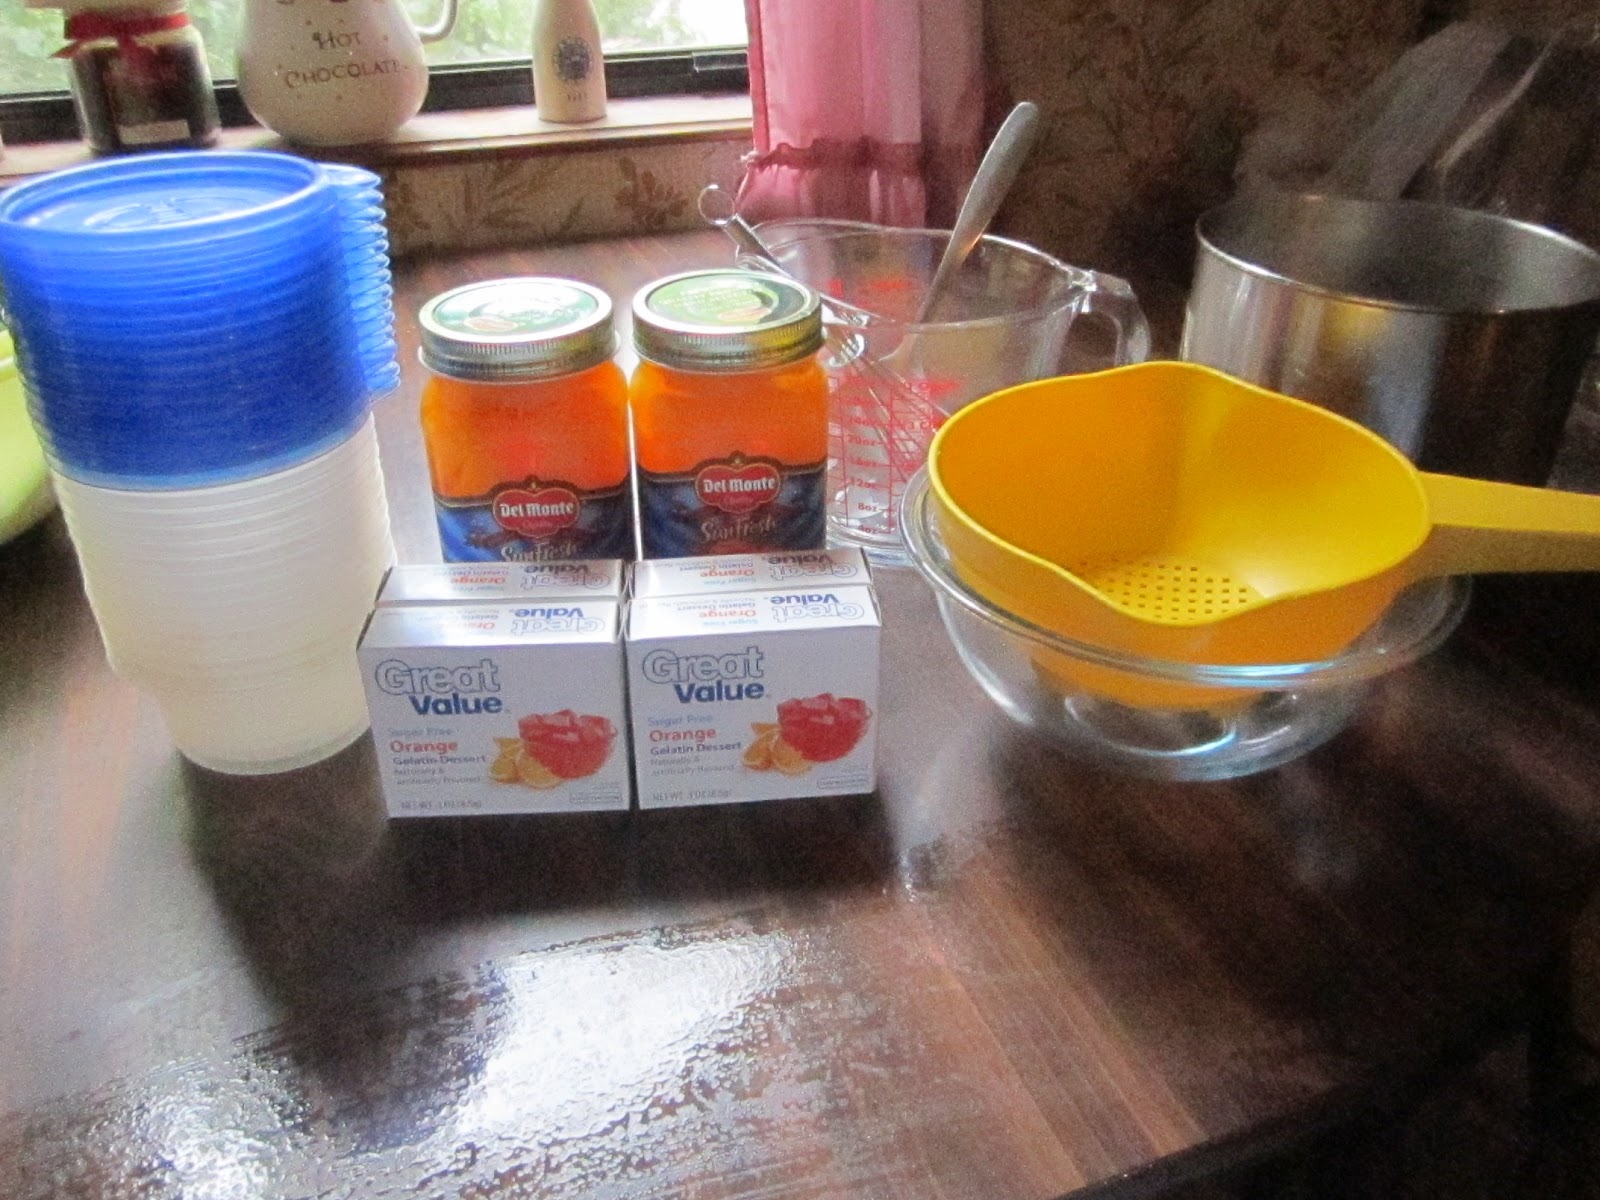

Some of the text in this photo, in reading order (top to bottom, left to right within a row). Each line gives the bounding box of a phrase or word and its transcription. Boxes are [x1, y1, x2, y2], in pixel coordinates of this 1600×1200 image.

[312, 31, 360, 49] HOT
[703, 476, 775, 493] Del Monte
[500, 501, 574, 518] Del Monte
[768, 554, 831, 565] Value
[525, 563, 589, 574] Value
[700, 569, 755, 578] Orange
[770, 593, 839, 606] Value
[515, 607, 584, 618] Value
[698, 610, 757, 619] Orange
[772, 602, 865, 623] Great
[511, 617, 605, 636] Great
[643, 646, 764, 684] Great
[375, 658, 500, 695] Great
[673, 680, 765, 704] Value
[408, 693, 503, 716] Value
[650, 728, 717, 743] Orange
[390, 740, 458, 755] Orange
[650, 742, 742, 756] Gelatin Dessert
